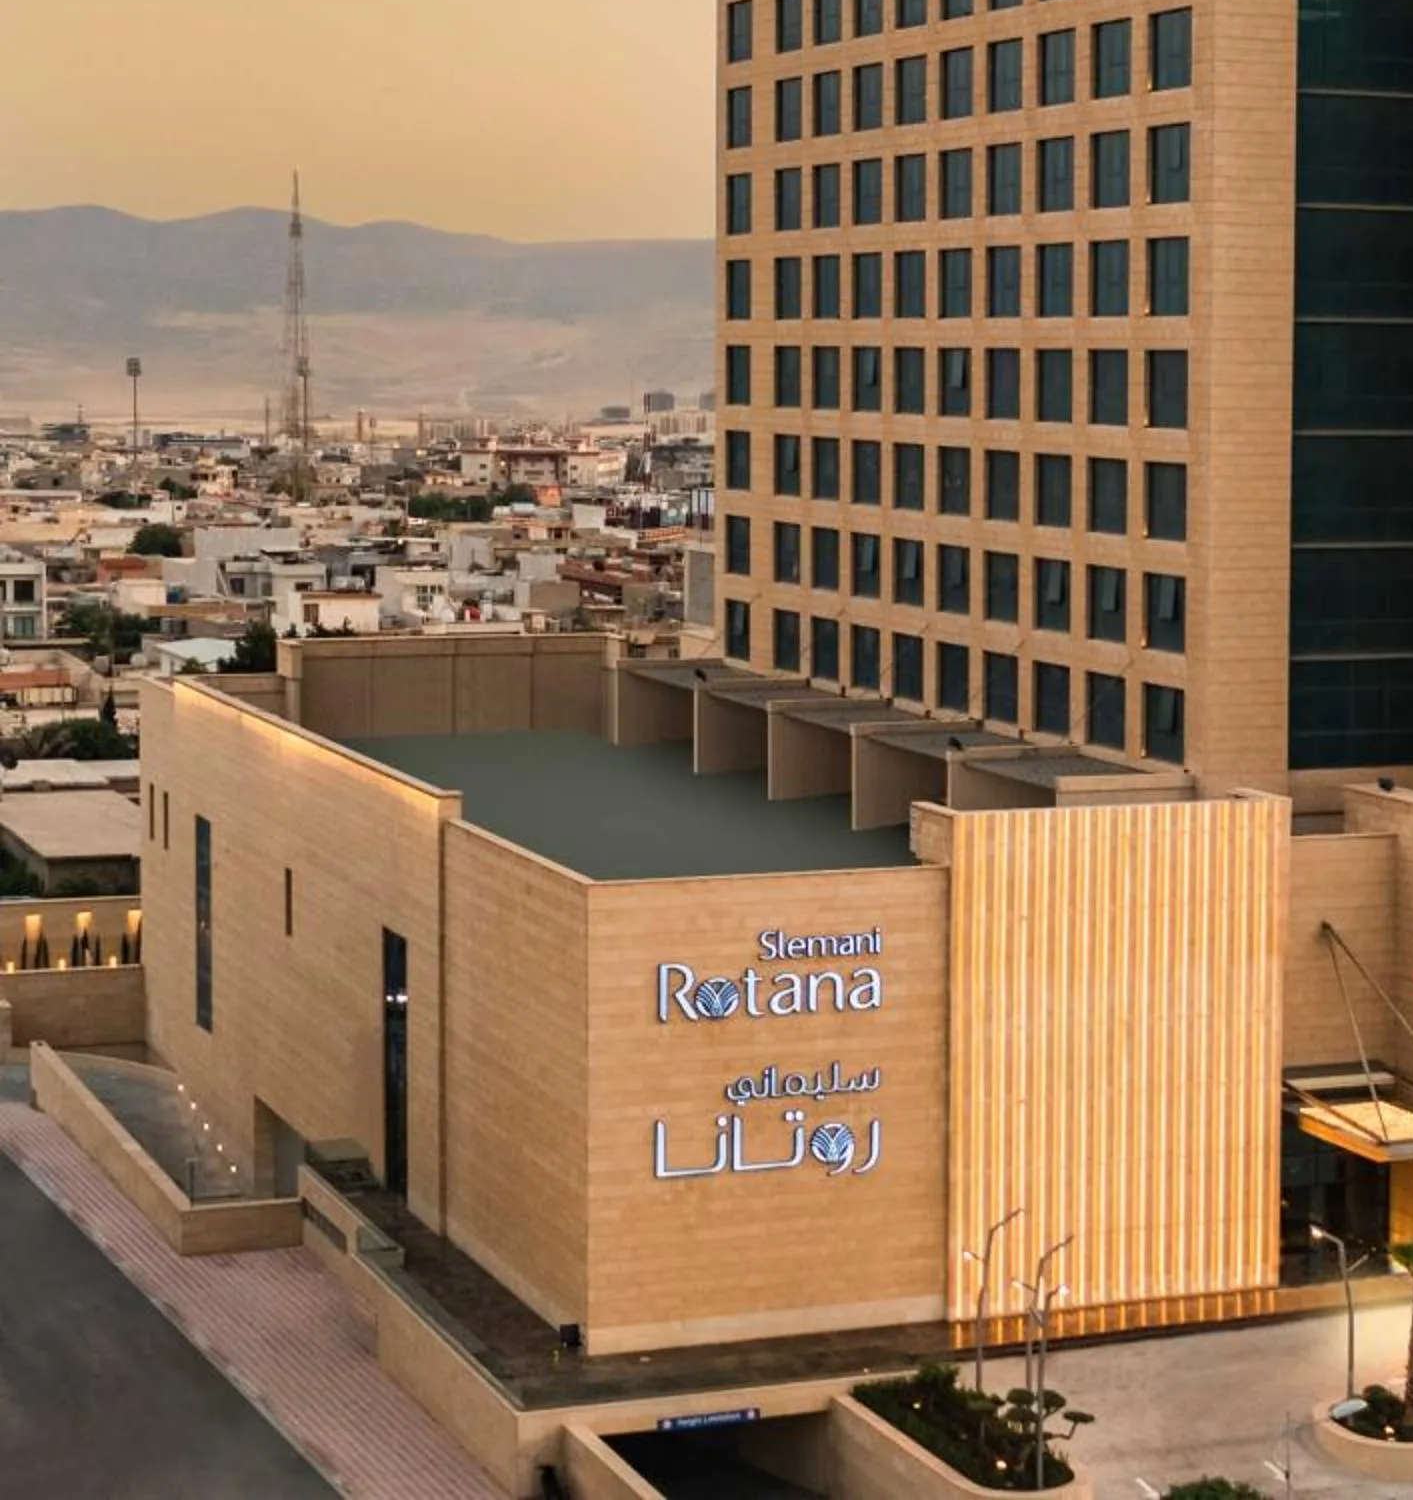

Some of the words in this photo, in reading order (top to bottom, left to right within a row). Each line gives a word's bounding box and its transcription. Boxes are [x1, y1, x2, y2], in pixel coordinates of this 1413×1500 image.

[758, 927, 882, 961] Slemani
[657, 962, 883, 1023] Rotana
[724, 1060, 882, 1106] سليماني
[654, 1109, 882, 1179] روتانا
